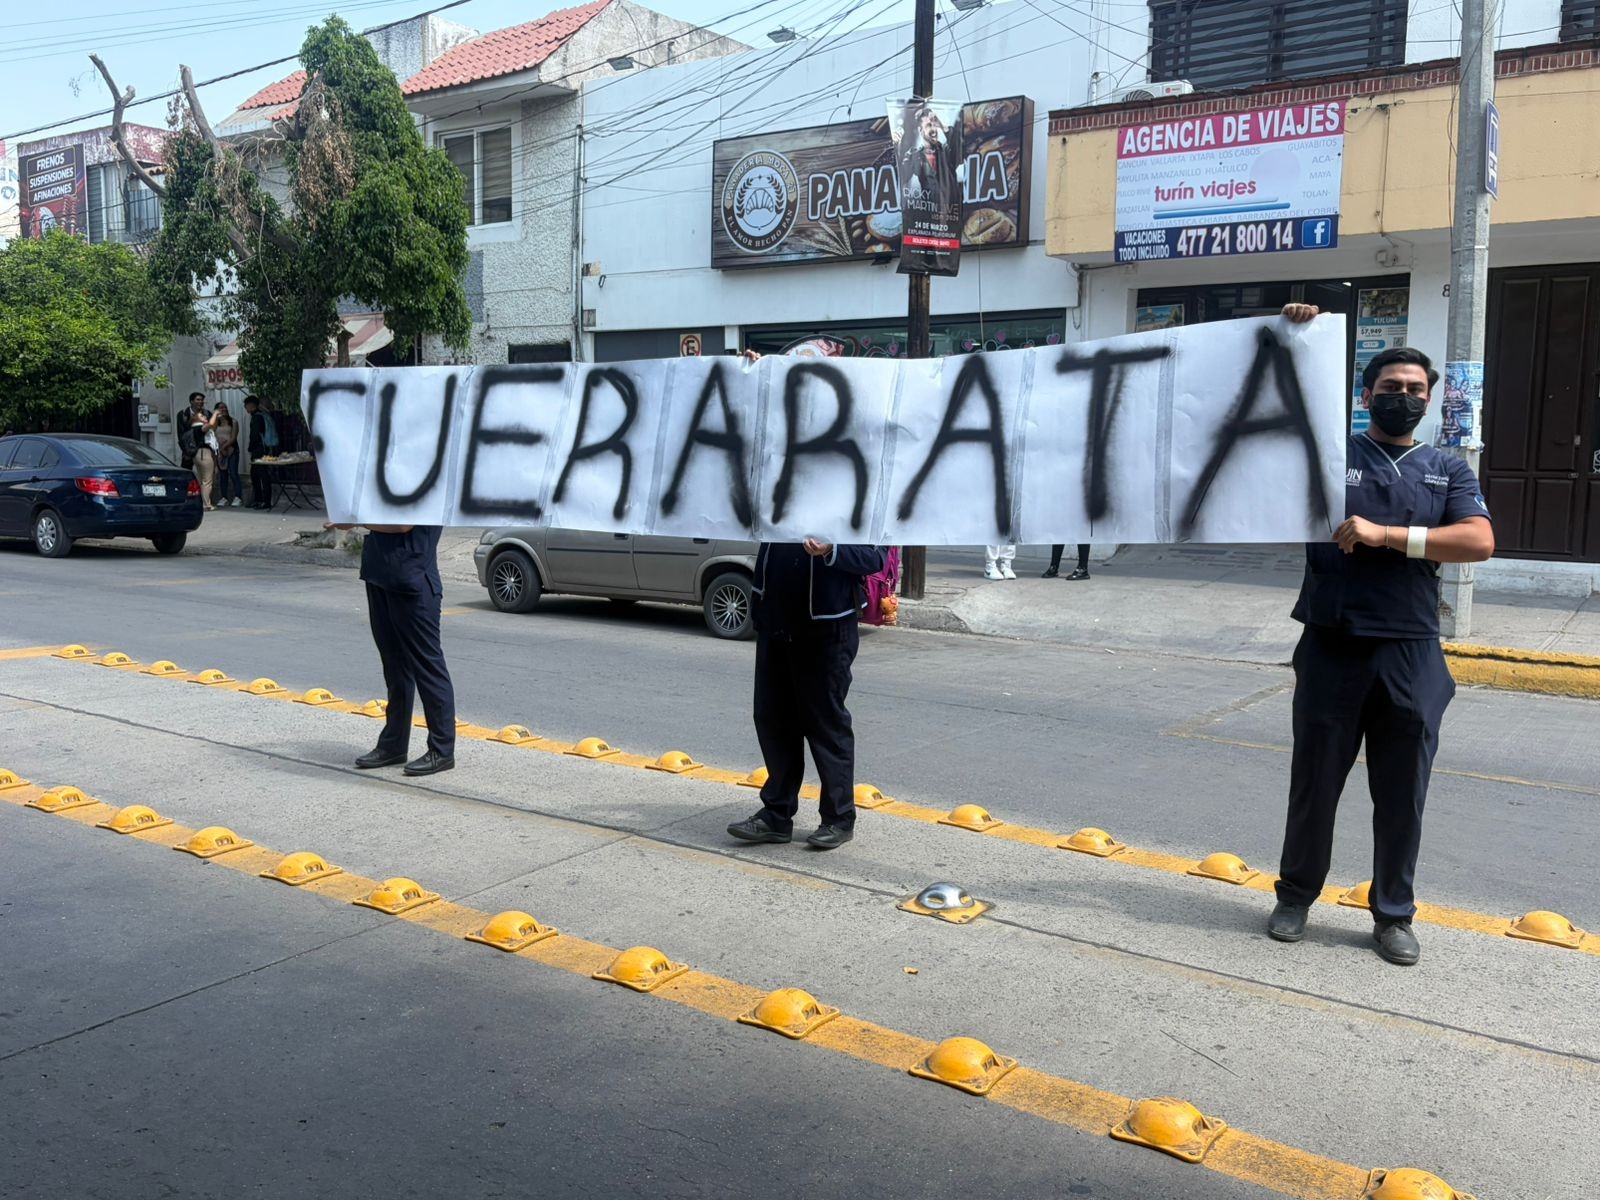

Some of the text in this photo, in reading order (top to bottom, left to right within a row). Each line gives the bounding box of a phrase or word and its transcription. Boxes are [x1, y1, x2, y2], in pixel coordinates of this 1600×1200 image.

[1122, 102, 1340, 155] AGENCIA DE VIAJES
[36, 153, 65, 172] FRENOS
[1150, 155, 1187, 166] VALLARTA
[1218, 149, 1234, 159] LOS
[1234, 147, 1261, 158] CABOS
[30, 167, 74, 188] SUSPENSIONES
[1151, 168, 1201, 180] MANZANILLO
[1205, 163, 1248, 175] HUATULCO
[33, 183, 72, 202] AFINACIONES
[1154, 179, 1257, 202] turín viajes
[907, 199, 938, 213] MARTIN
[1237, 210, 1288, 222] BARRANCAS
[733, 229, 753, 246] AMOR
[755, 230, 782, 247] HECHO
[782, 209, 793, 229] PAN
[923, 222, 930, 230] DE
[930, 223, 949, 232] MARZO
[1124, 230, 1166, 245] VACACIONES
[1177, 228, 1207, 256] 477
[1211, 226, 1230, 254] 21
[1236, 223, 1267, 253] 800
[1272, 221, 1294, 250] 14
[1119, 245, 1170, 261] TODO INCLUIDO
